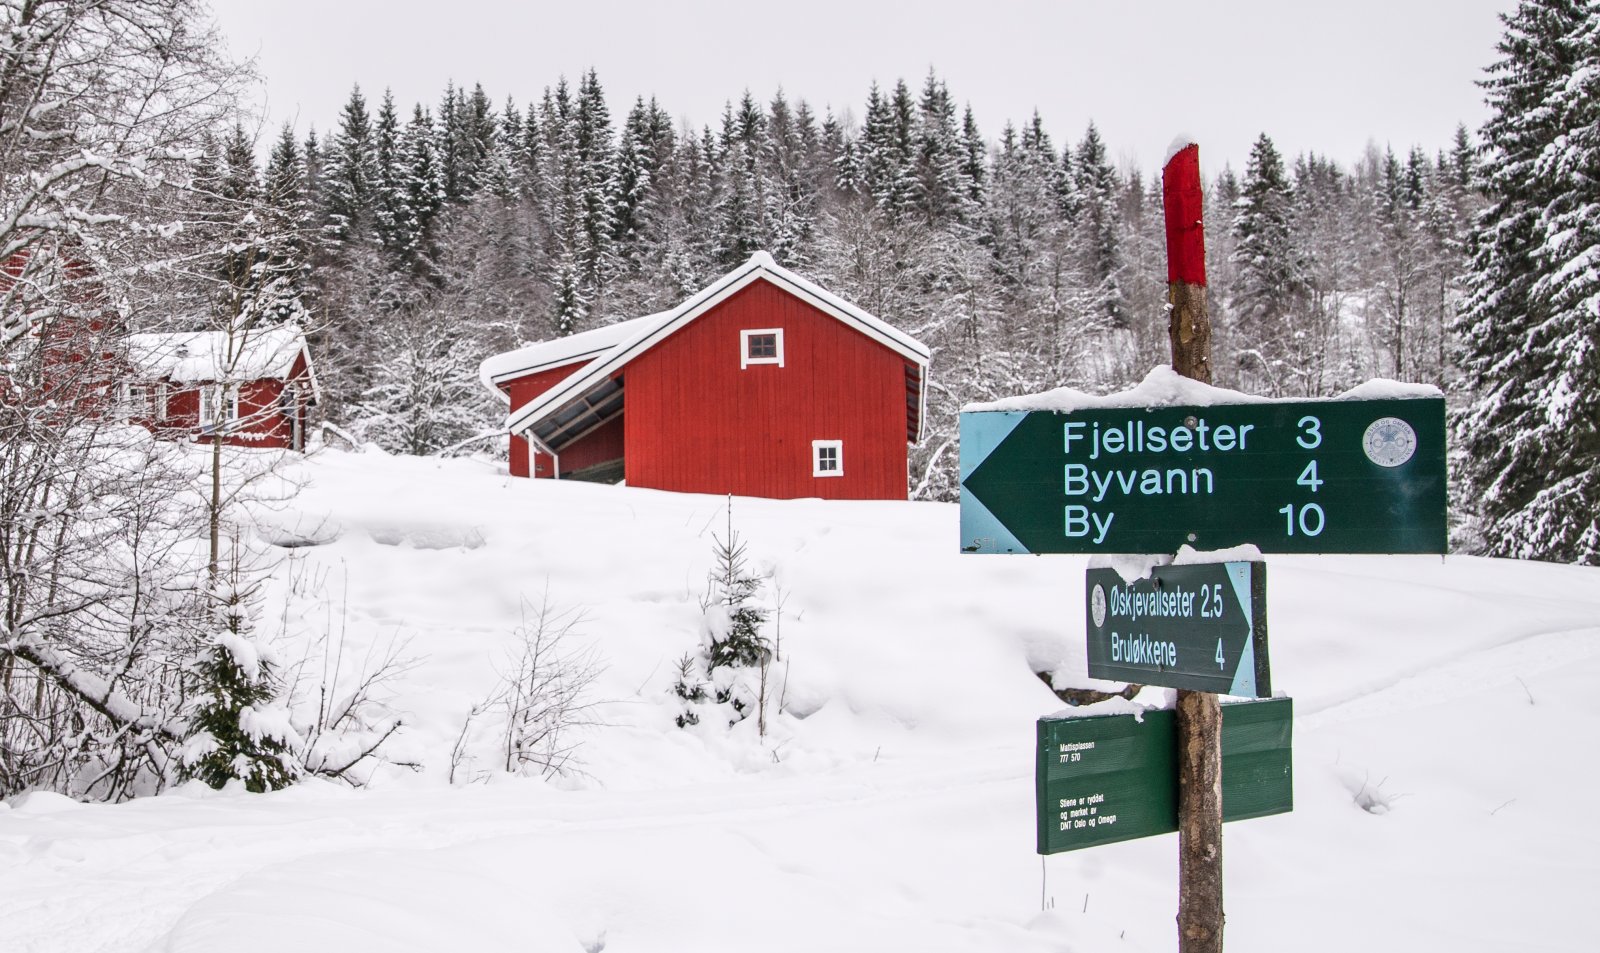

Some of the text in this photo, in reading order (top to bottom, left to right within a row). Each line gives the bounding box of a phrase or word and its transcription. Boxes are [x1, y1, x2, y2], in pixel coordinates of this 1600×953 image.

[1063, 415, 1322, 459] Fjellseter 3
[1064, 460, 1324, 502] Byvann 4
[1064, 503, 1325, 544] By 10
[1110, 584, 1195, 621] Øskjevallseter
[1201, 583, 1223, 618] 2,5
[1112, 632, 1225, 670] Bruløkkene 4
[1060, 742, 1095, 752] Mattisplassen
[1060, 753, 1081, 763] 777 570
[1060, 799, 1077, 808] Stiene
[1087, 794, 1104, 805] ryddet
[1060, 807, 1097, 820] og merket av
[1060, 815, 1117, 831] DNT Oslo og Omegn
